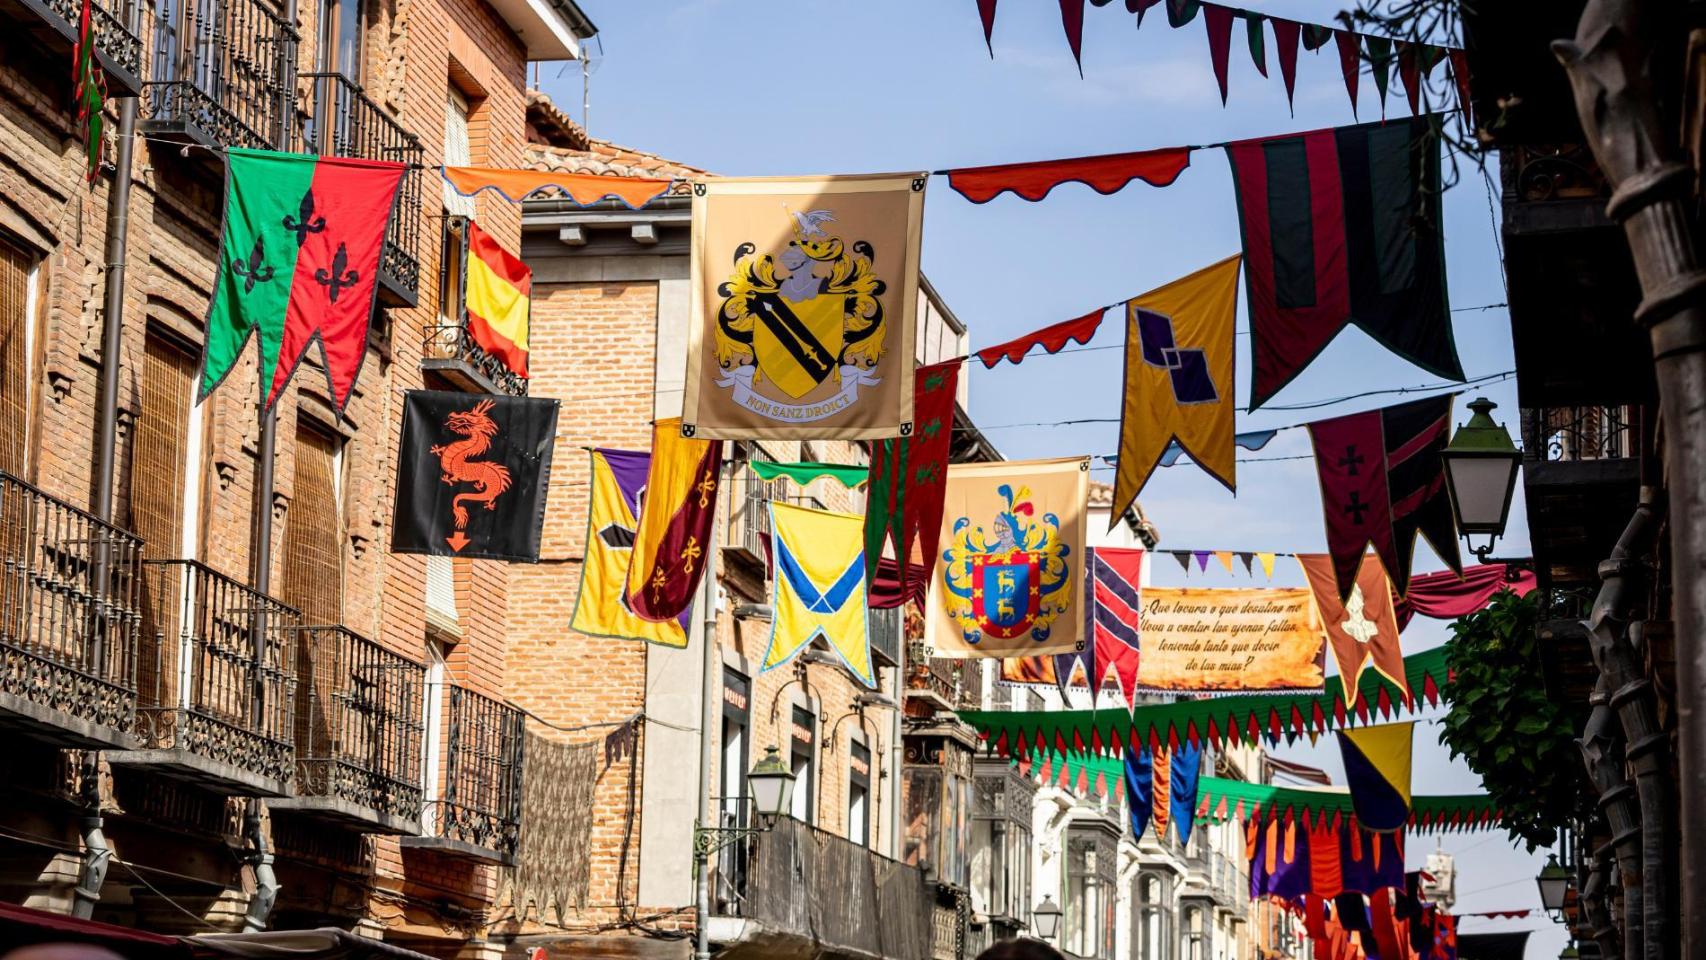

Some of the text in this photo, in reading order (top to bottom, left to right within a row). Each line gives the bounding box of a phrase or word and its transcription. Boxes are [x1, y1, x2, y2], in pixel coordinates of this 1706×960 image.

[746, 394, 850, 418] NON SANZ DROICT
[1172, 601, 1207, 613] locura
[1209, 606, 1217, 614] o
[1218, 605, 1239, 617] que
[1240, 601, 1284, 613] desatino
[1286, 604, 1302, 612] me
[1140, 619, 1165, 632] lleva
[1166, 624, 1174, 632] a
[1176, 620, 1210, 632] contar
[1212, 620, 1229, 632] las
[1230, 623, 1264, 637] ajenas
[1158, 638, 1280, 656] teniendo tanto que decir
[1185, 658, 1198, 671] de
[1200, 658, 1216, 671] las
